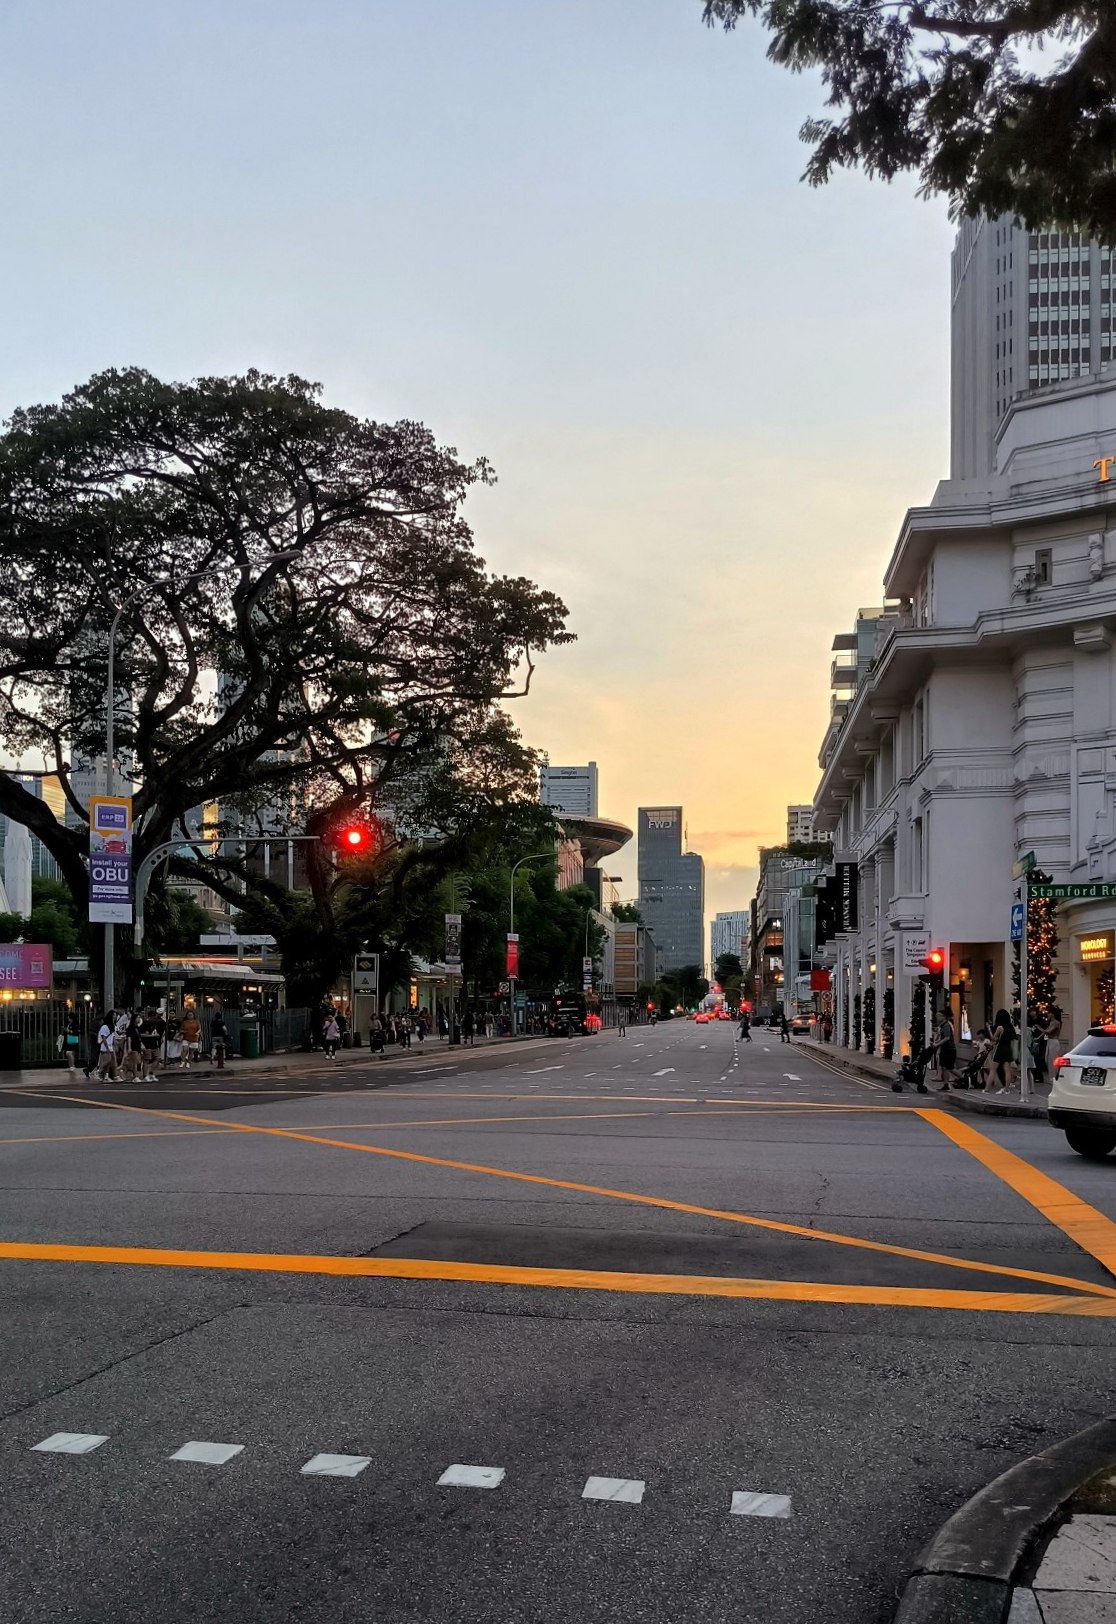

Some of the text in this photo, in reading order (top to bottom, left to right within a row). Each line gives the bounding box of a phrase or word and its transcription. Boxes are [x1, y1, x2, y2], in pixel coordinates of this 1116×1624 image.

[648, 820, 672, 829] FWD
[781, 858, 817, 869] CapitaLand
[92, 867, 129, 882] OBU
[1031, 886, 1096, 897] Stamford
